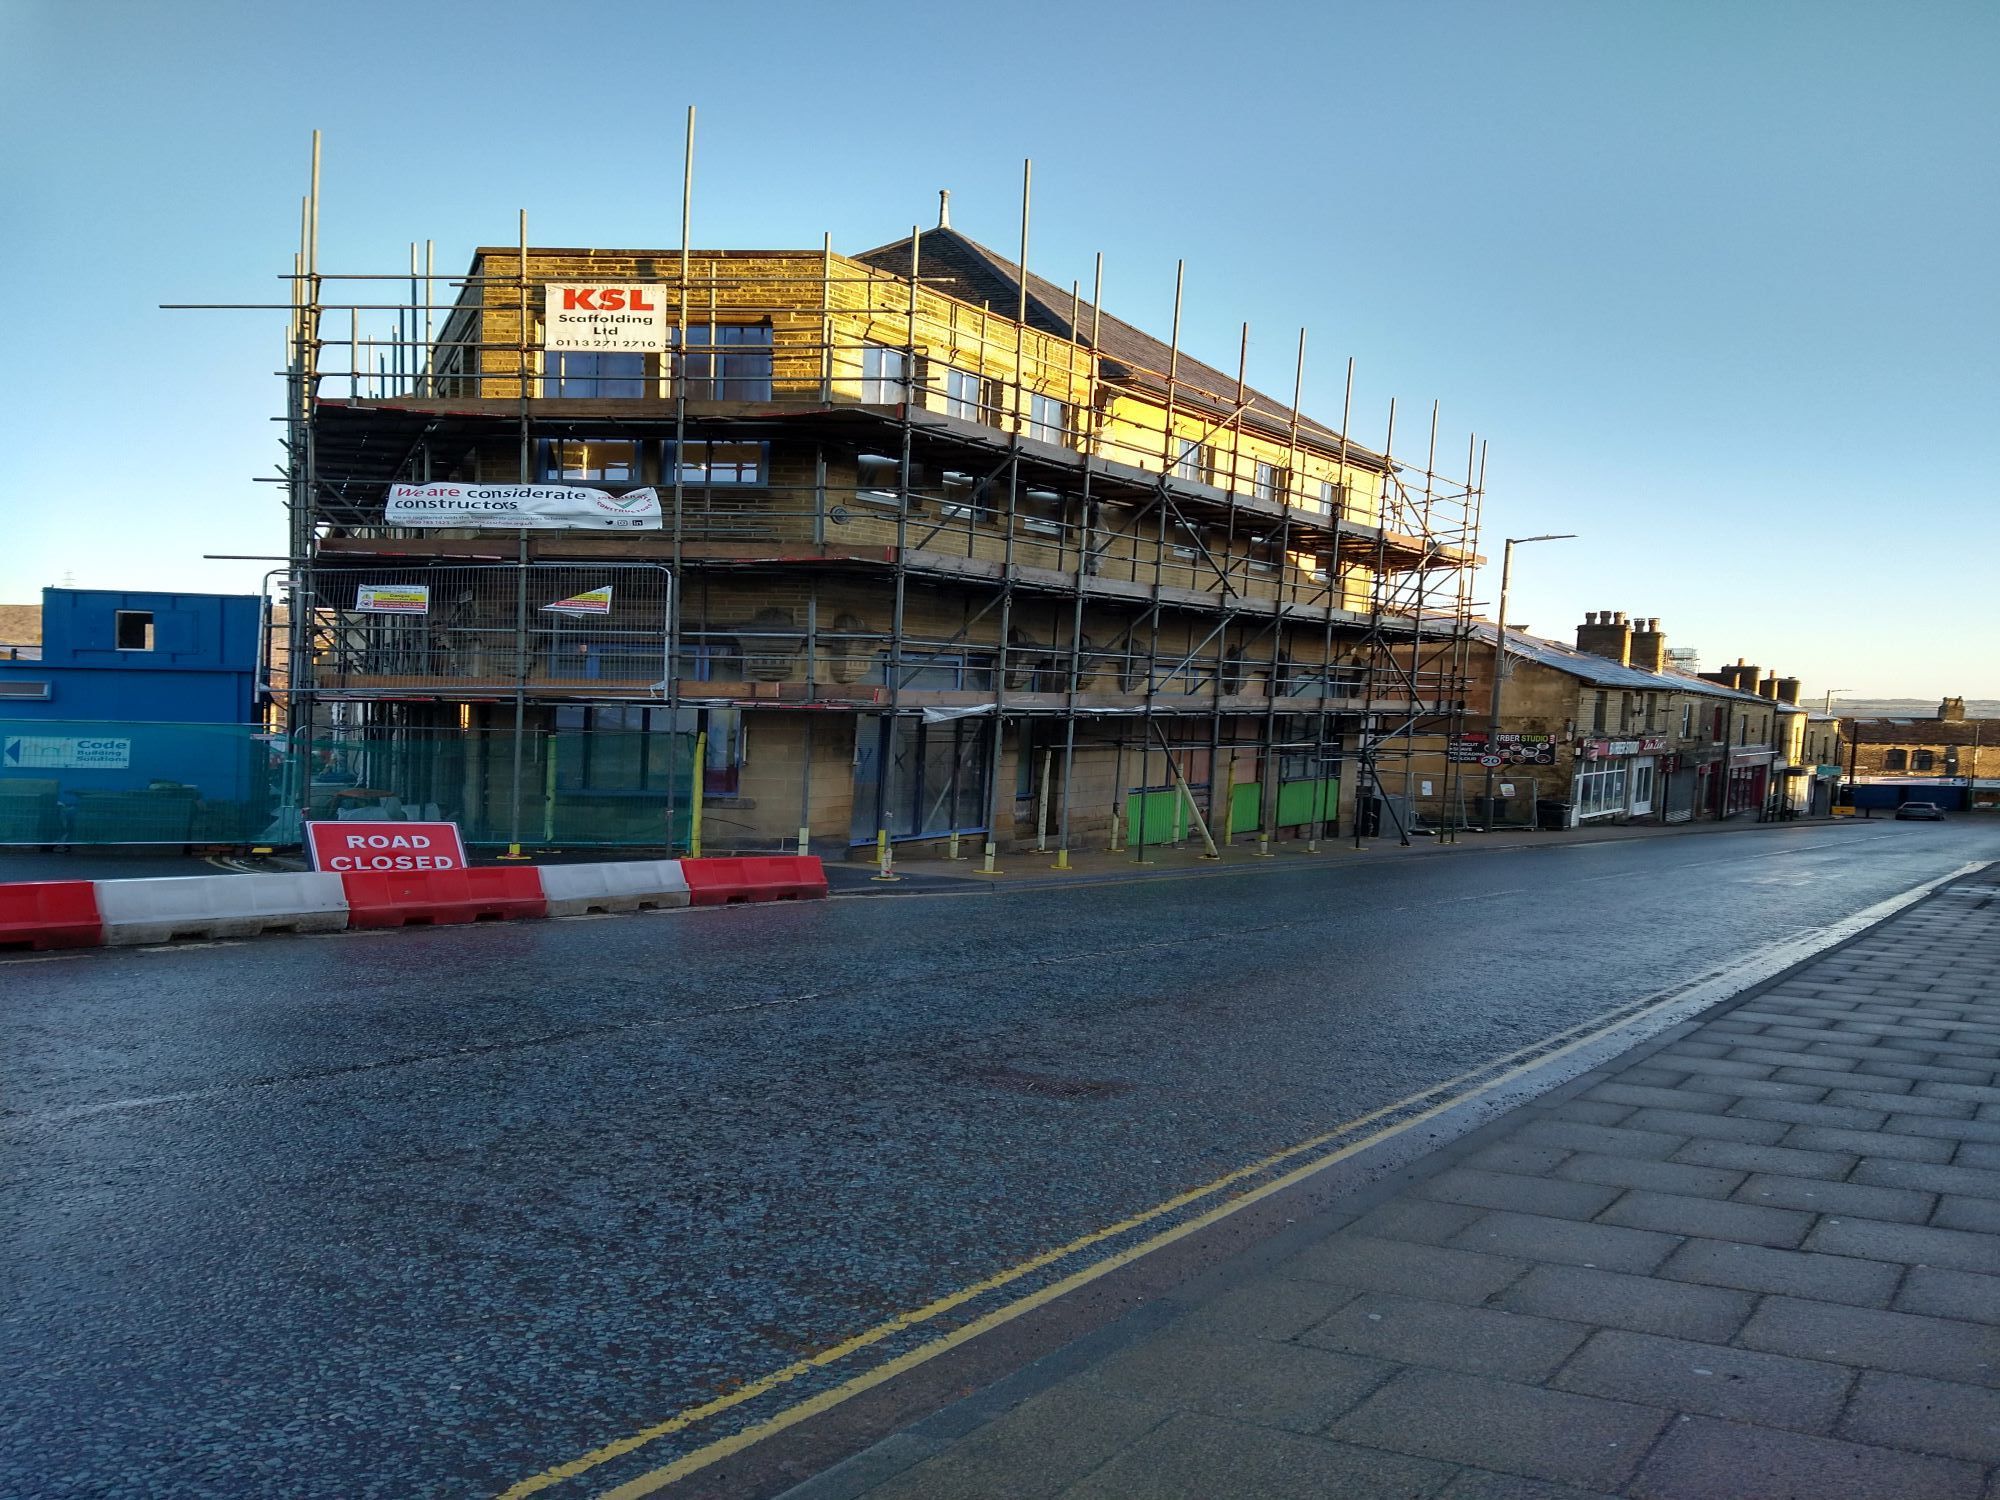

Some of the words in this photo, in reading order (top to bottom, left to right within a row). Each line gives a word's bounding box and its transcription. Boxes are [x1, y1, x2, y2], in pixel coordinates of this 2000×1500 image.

[563, 289, 654, 311] KSL
[558, 314, 653, 326] Scaffolding
[593, 327, 618, 335] Ltd
[556, 339, 590, 347] 0113
[593, 339, 618, 347] 271
[622, 340, 656, 348] 2710
[397, 487, 424, 497] We
[427, 488, 460, 497] are
[467, 487, 586, 500] considerate
[395, 500, 518, 510] constructors
[1497, 734, 1520, 742] RBER
[1521, 735, 1549, 743] STUDIO
[77, 740, 127, 749] Code
[1483, 757, 1499, 765] 20
[346, 835, 430, 849] ROAD
[330, 856, 453, 870] CLOSED
